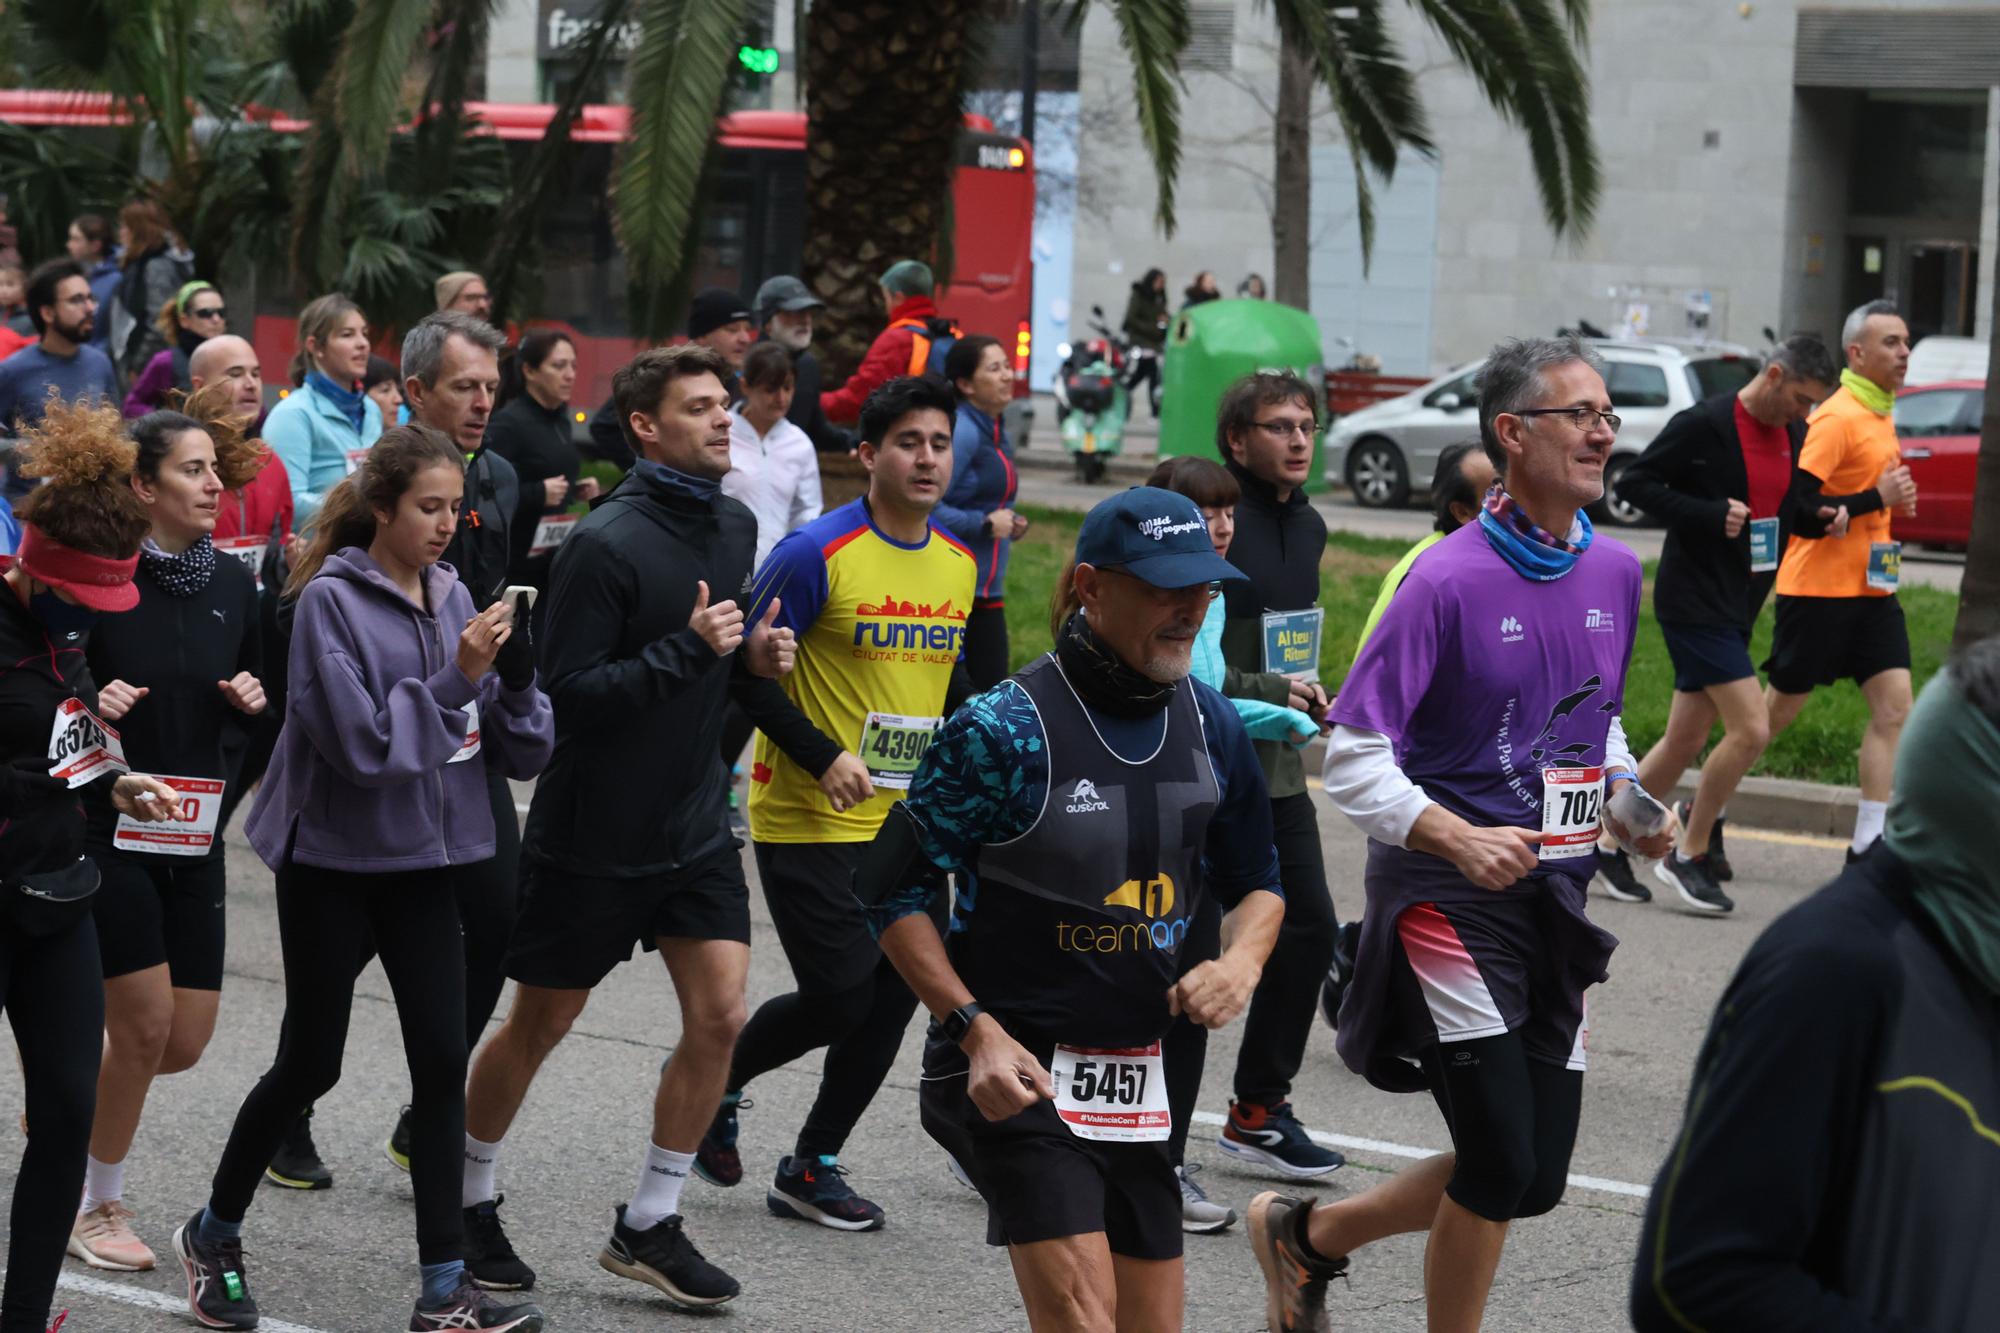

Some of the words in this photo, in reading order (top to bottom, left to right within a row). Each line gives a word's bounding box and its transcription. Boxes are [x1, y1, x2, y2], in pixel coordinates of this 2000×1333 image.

[1277, 630, 1291, 647] Al
[852, 649, 898, 662] CIUTAT
[902, 653, 917, 662] DE
[872, 729, 929, 760] 4390
[1066, 801, 1110, 813] austral
[1071, 1062, 1147, 1105] 5457
